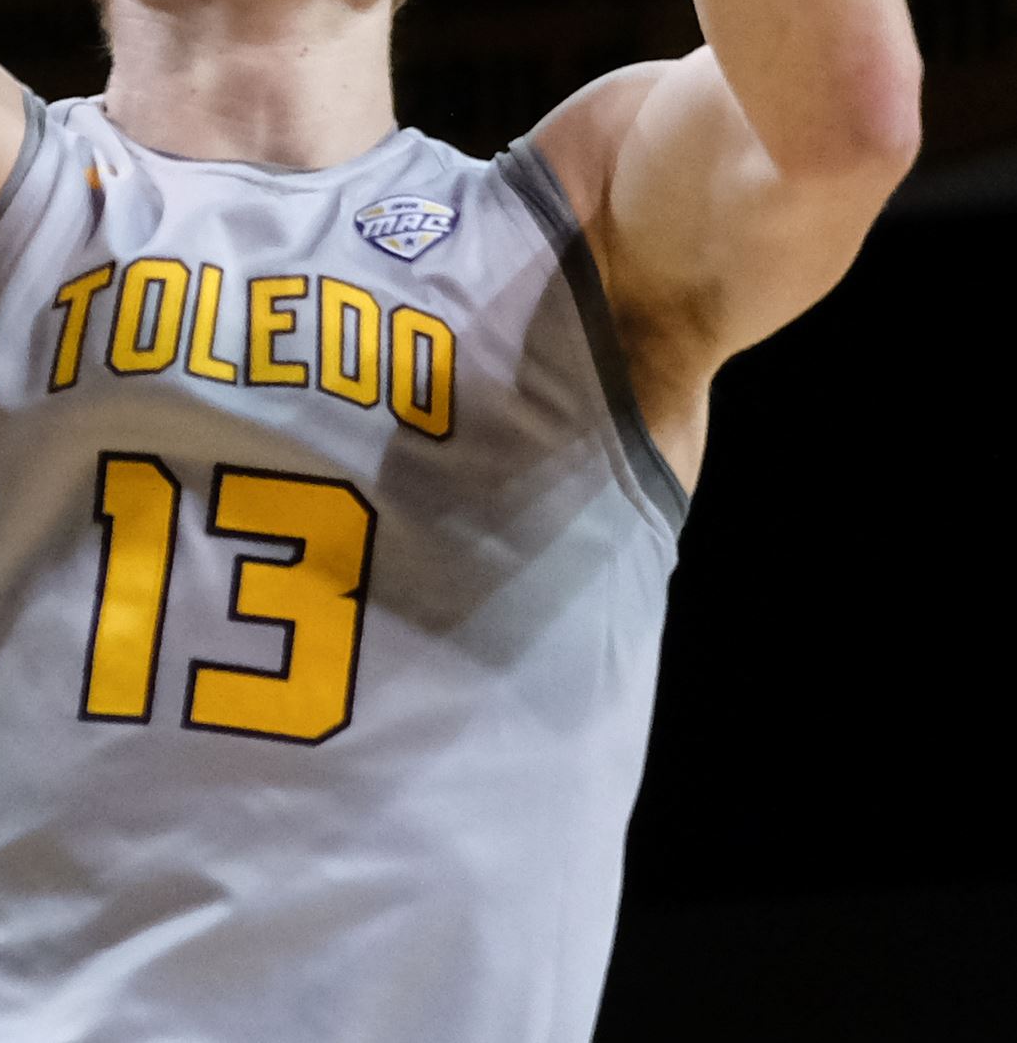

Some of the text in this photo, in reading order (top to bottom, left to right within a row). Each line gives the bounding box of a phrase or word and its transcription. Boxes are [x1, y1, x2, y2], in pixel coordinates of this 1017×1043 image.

[362, 213, 451, 238] MAC
[48, 258, 456, 438] TOLEDO
[78, 451, 378, 747] 13
